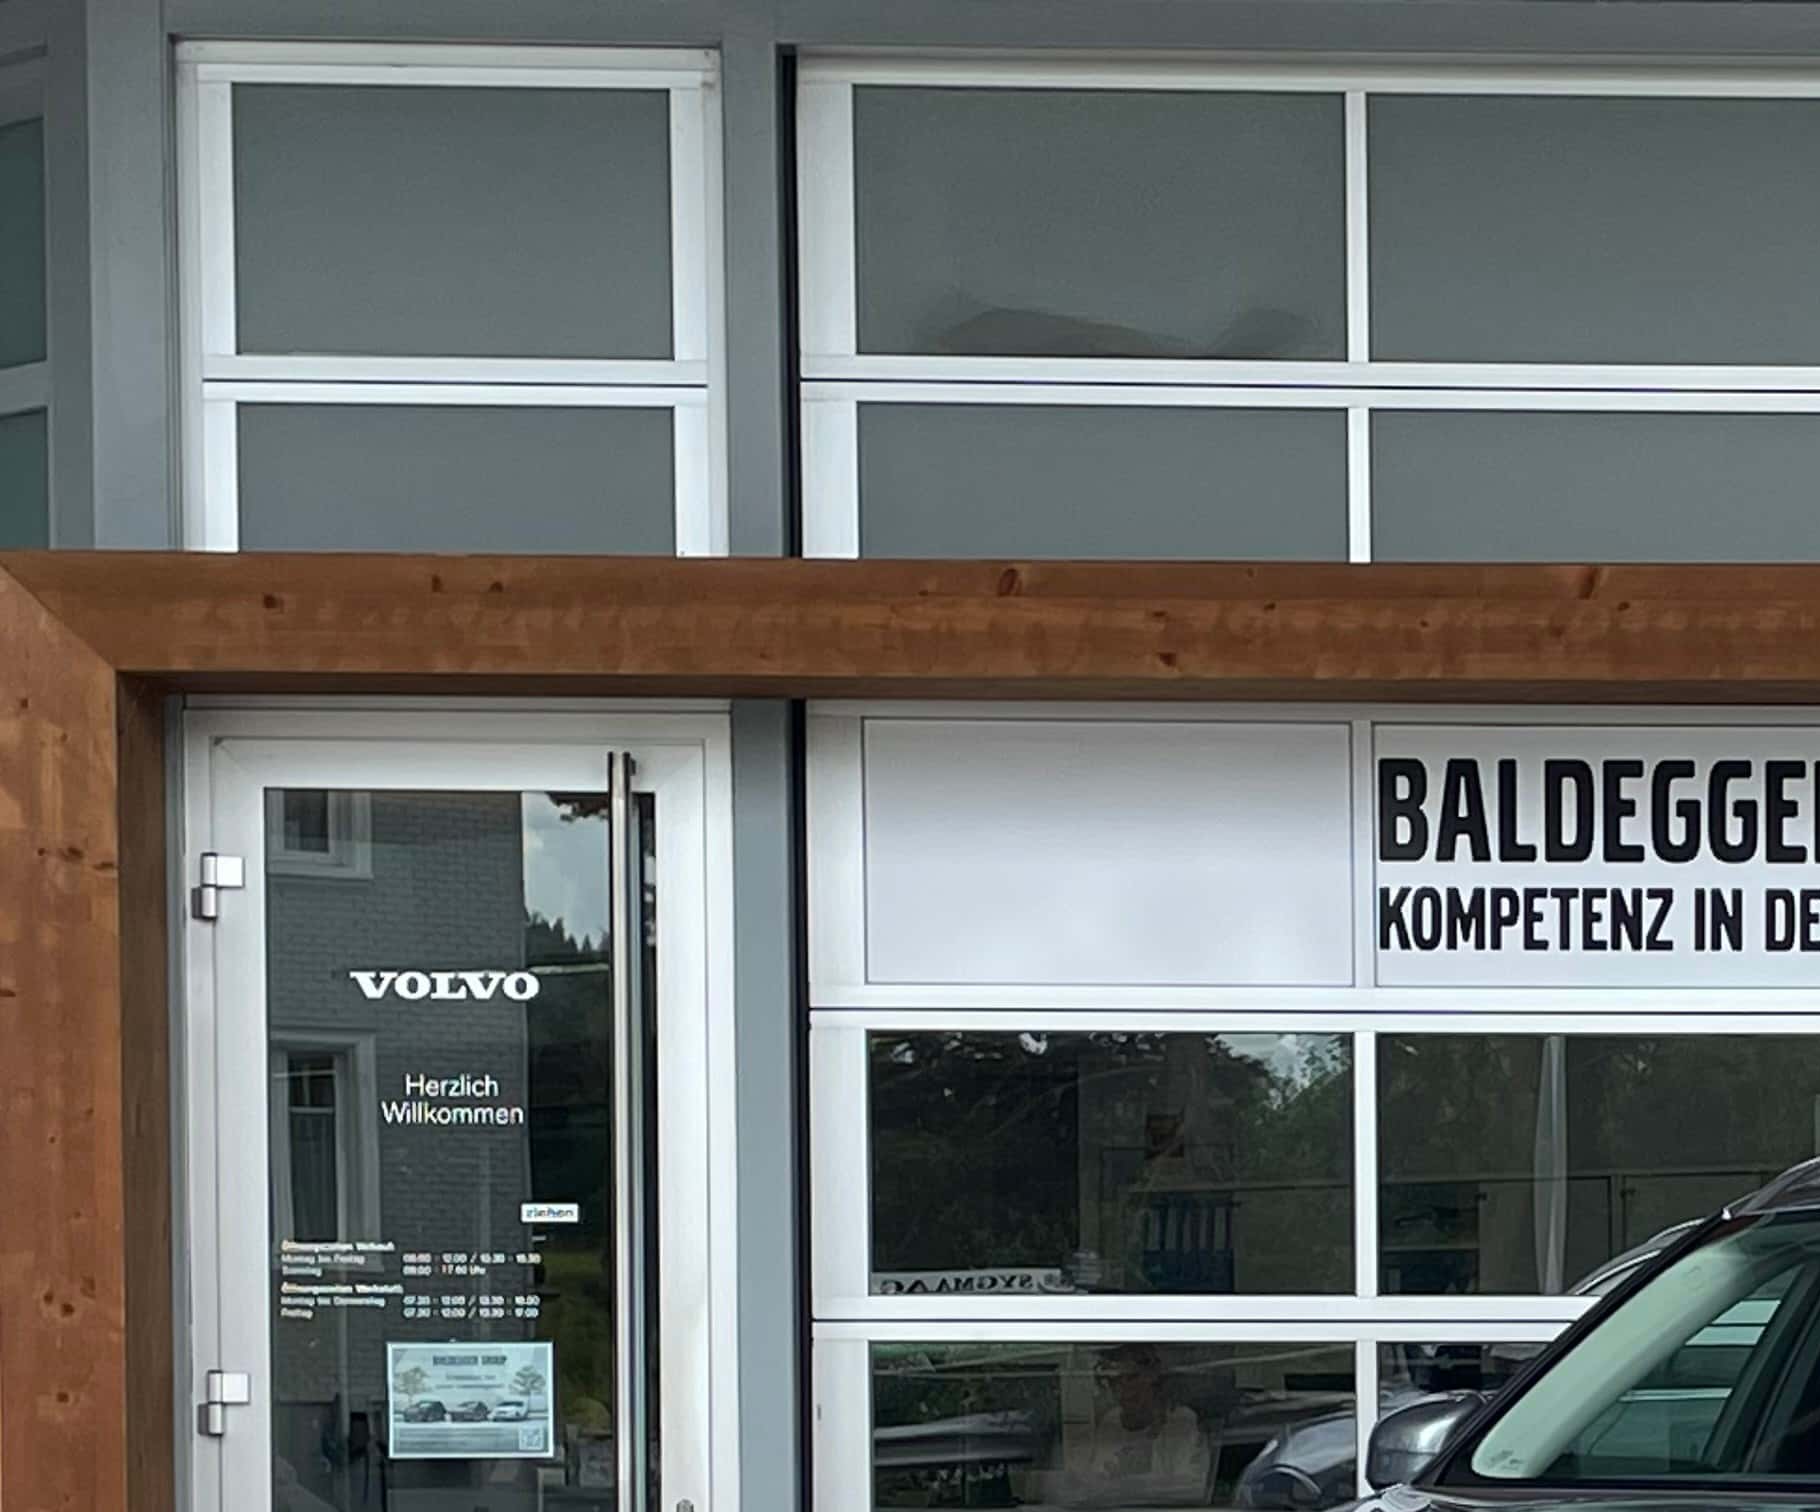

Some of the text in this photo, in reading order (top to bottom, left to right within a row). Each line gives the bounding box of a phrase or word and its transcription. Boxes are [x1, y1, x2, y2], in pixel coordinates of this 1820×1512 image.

[1378, 886, 1674, 952] KOMPETENZ
[1694, 888, 1743, 952] IN
[350, 971, 541, 1000] VOLVO
[404, 1073, 500, 1097] Herzlich
[381, 1101, 525, 1126] Willkommen
